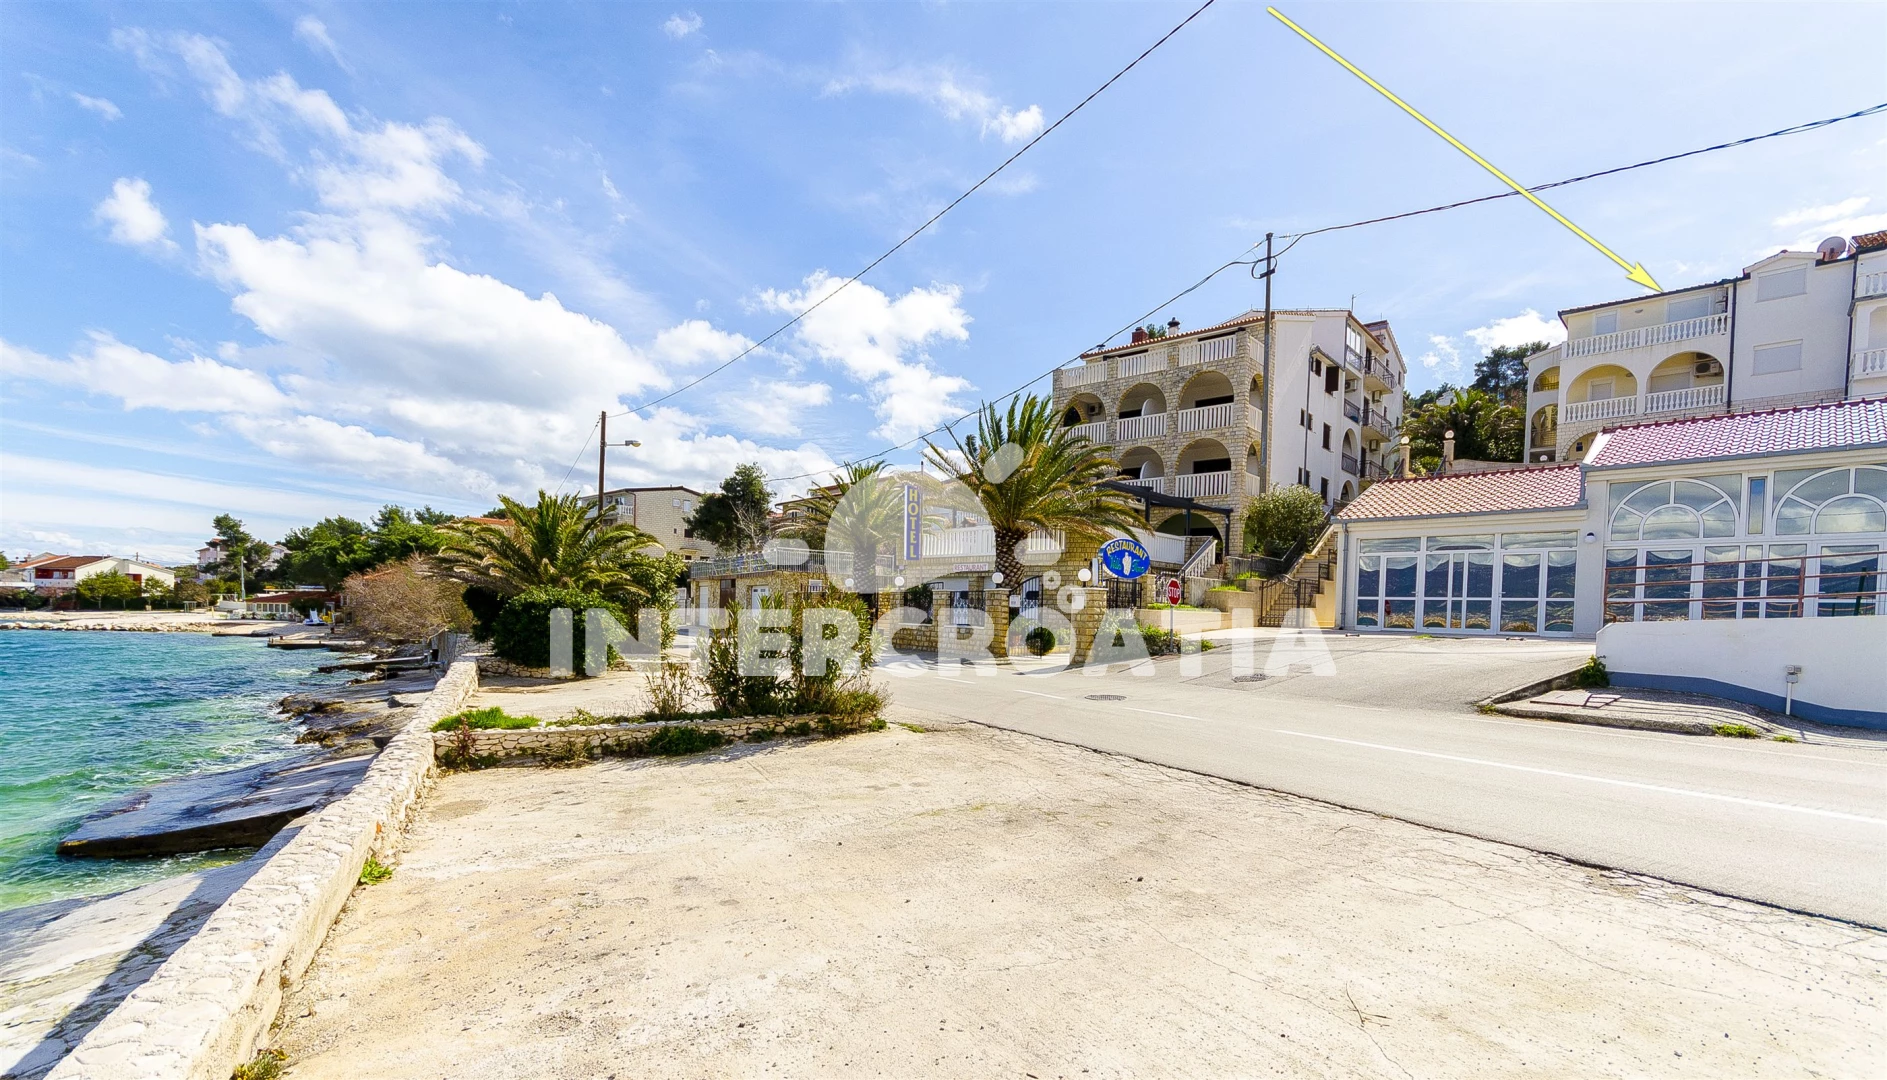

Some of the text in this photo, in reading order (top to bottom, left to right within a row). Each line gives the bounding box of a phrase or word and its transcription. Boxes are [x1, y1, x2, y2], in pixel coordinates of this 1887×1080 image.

[908, 488, 919, 558] HOTEL
[1106, 541, 1148, 560] RESTAURANT
[1168, 586, 1180, 598] STOP
